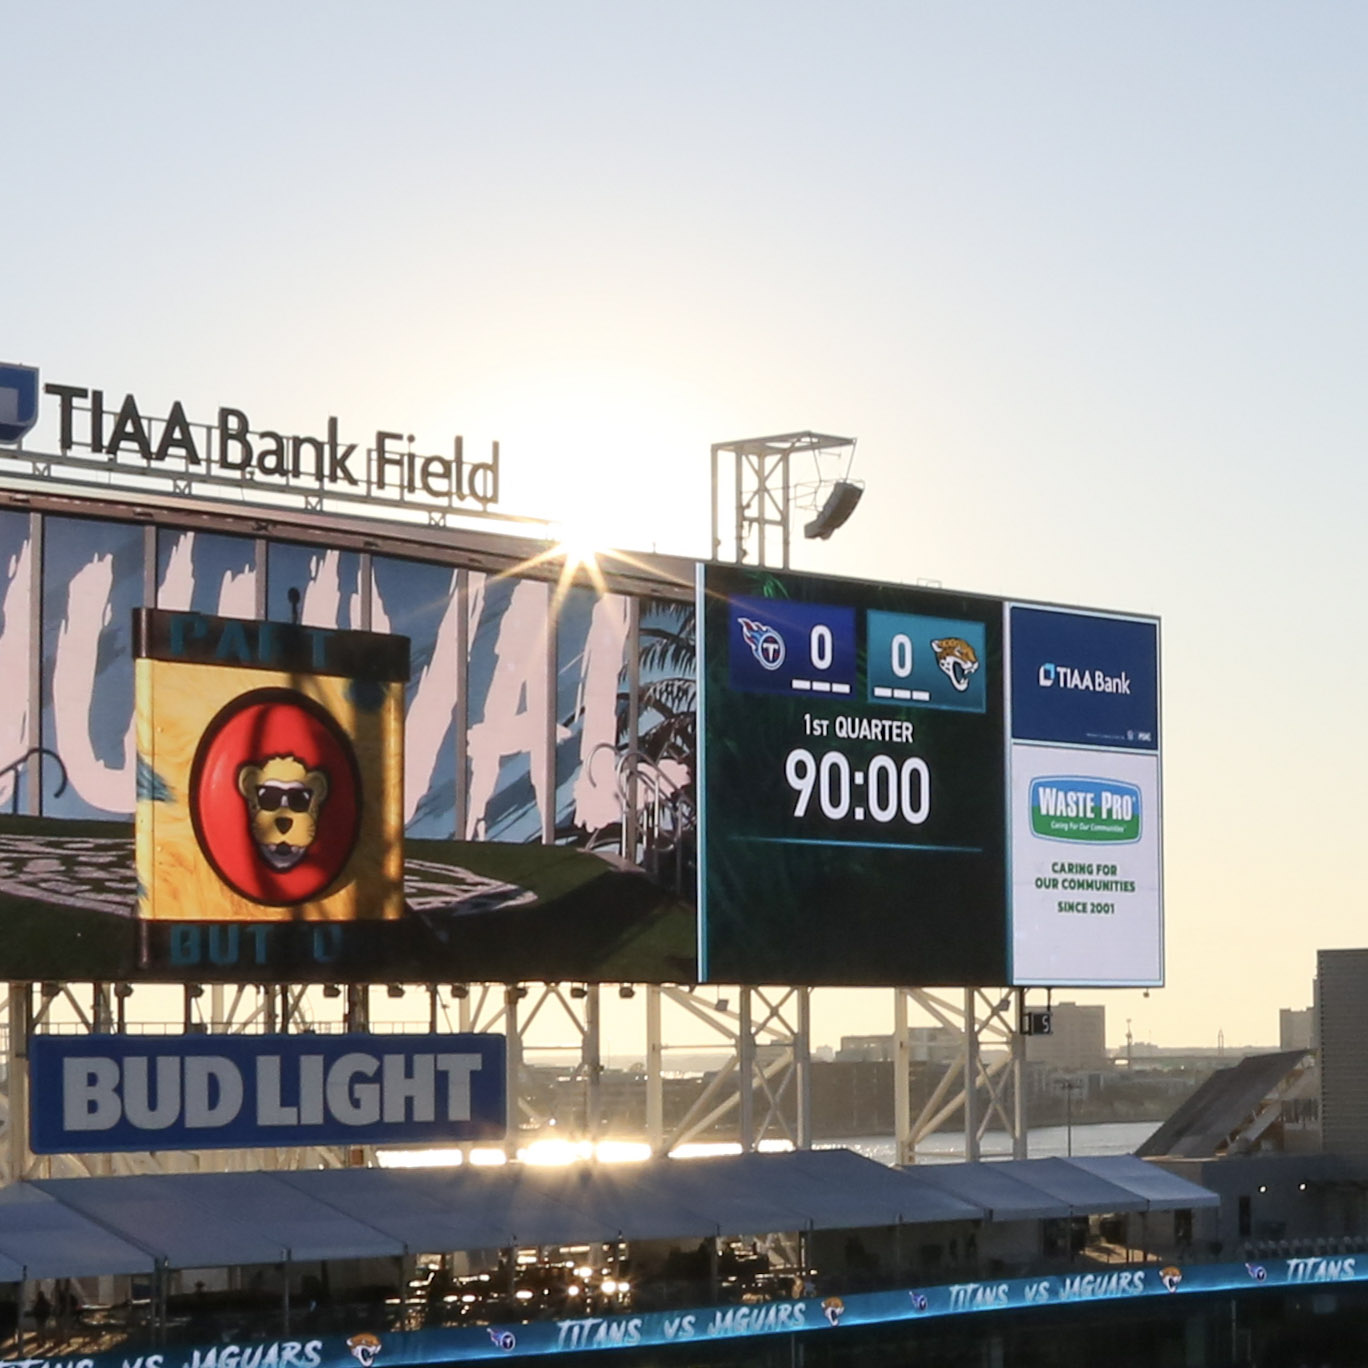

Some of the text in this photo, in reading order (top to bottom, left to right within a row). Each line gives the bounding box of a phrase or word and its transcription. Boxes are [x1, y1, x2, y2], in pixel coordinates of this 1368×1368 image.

[45, 383, 499, 504] TIAA Bank Field
[810, 624, 832, 670] 0
[891, 633, 912, 678] 0
[1057, 667, 1131, 695] TIAA Bank
[804, 713, 914, 743] 1ST QUARTER
[785, 748, 930, 824] 90:00
[1038, 787, 1095, 819] WASTE
[1035, 877, 1136, 893] OUR COMMUNITIES
[1051, 861, 1117, 876] CARING FOR
[1058, 901, 1115, 914] SINCE 2001
[62, 1052, 483, 1132] BUD LIGHT
[1287, 1255, 1355, 1281] TITANS
[948, 1272, 1145, 1307] TITANS VS JAGUARS
[558, 1303, 806, 1348] TITANS VS JAGUARS
